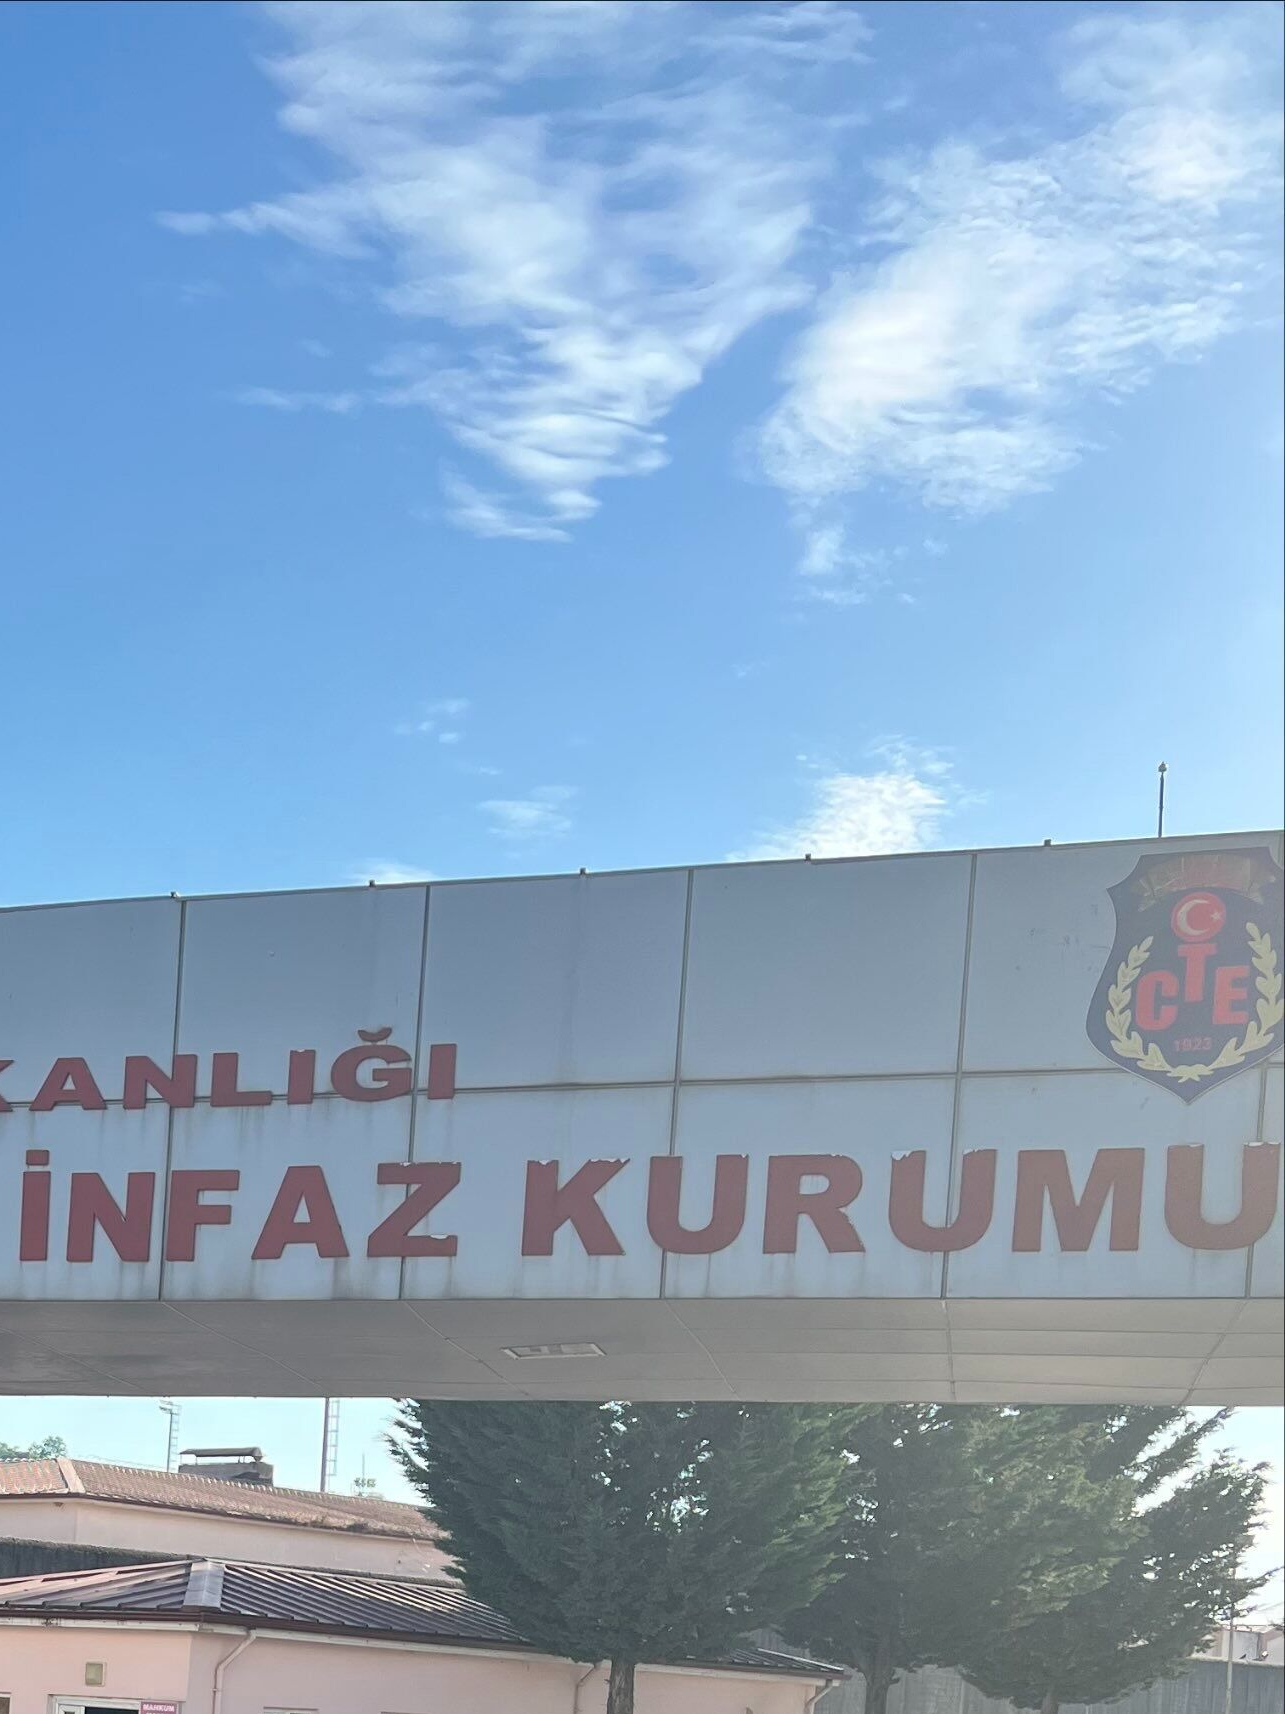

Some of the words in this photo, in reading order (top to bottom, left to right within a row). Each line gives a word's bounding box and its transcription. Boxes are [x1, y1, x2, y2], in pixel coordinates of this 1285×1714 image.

[1135, 943, 1249, 1031] CTE
[1174, 1037, 1212, 1052] 1923
[19, 1149, 462, 1263] İNFAZ
[521, 1142, 1280, 1257] KURUMU
